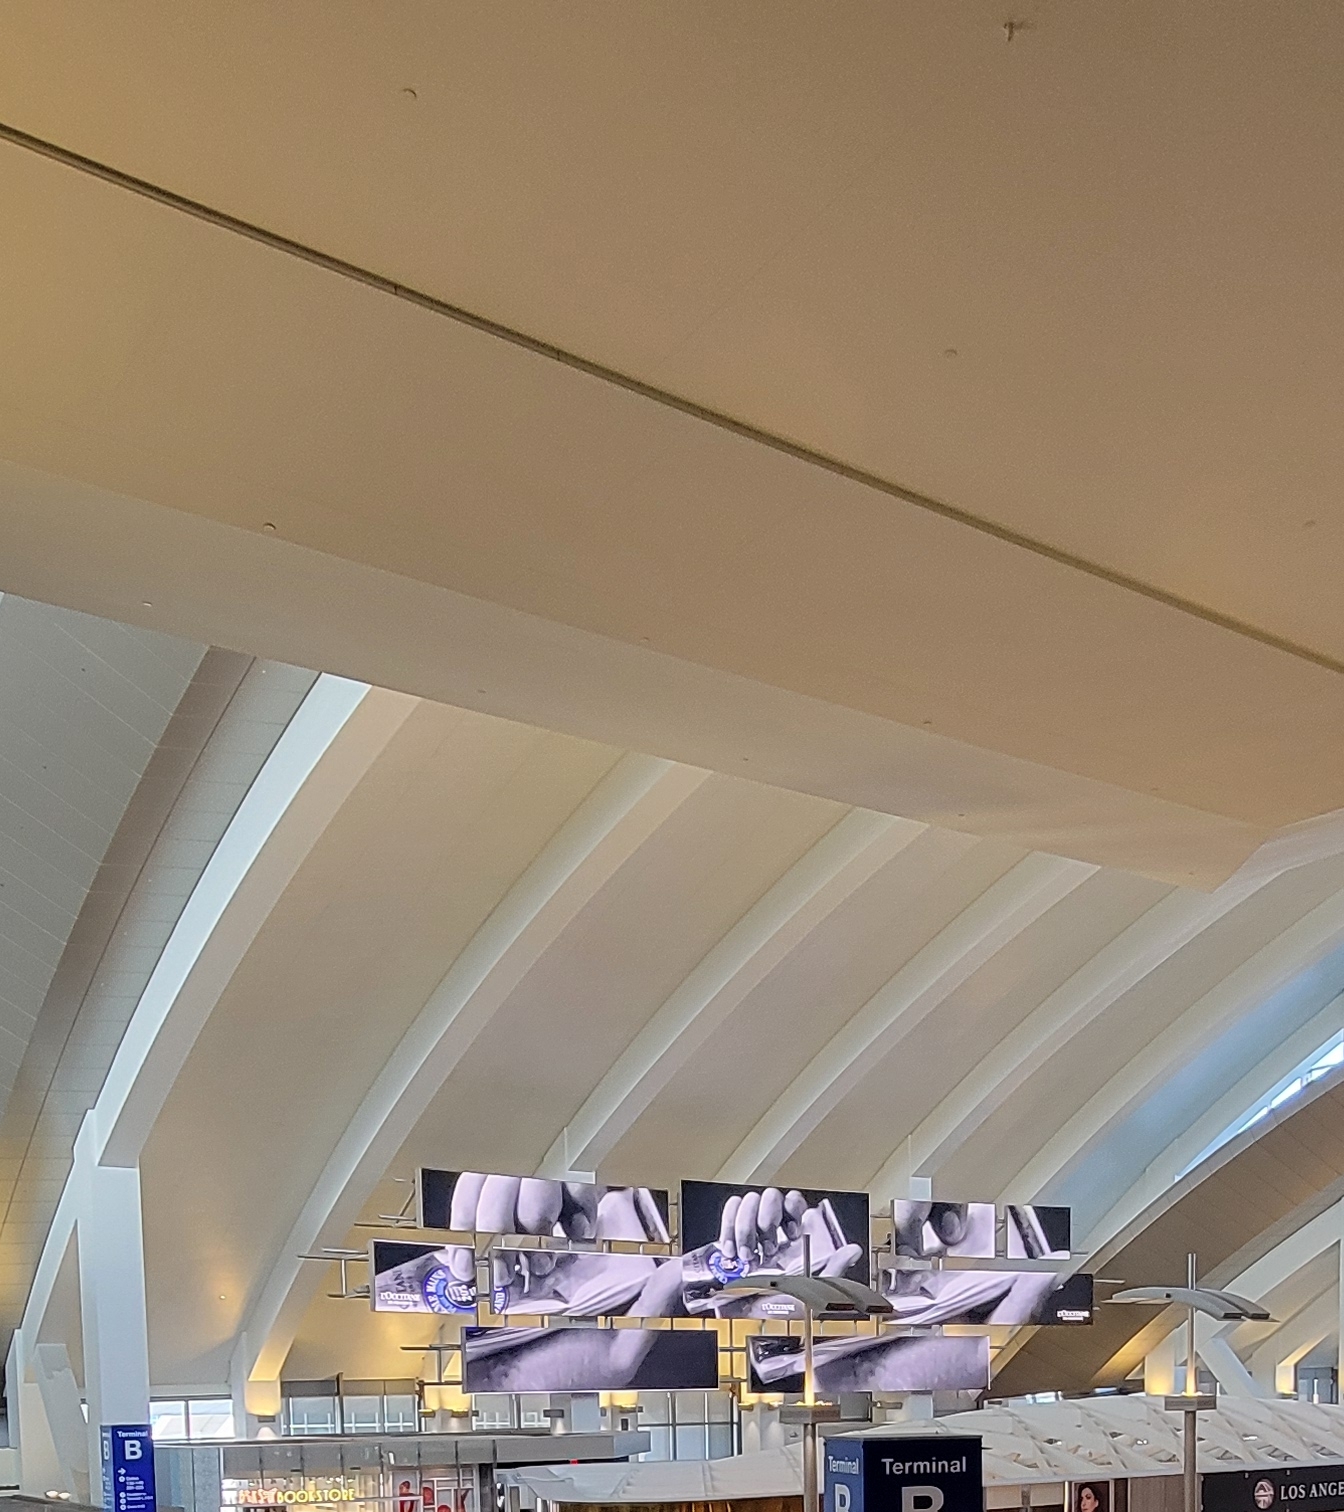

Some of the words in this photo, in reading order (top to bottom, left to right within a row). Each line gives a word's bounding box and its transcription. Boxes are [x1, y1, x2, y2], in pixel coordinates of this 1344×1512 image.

[117, 1430, 148, 1438] Terminal
[124, 1440, 143, 1460] B
[828, 1455, 859, 1475] Terminal
[881, 1456, 966, 1475] Terminal
[277, 1488, 356, 1504] BOOKSTORE
[1280, 1484, 1306, 1501] LOS
